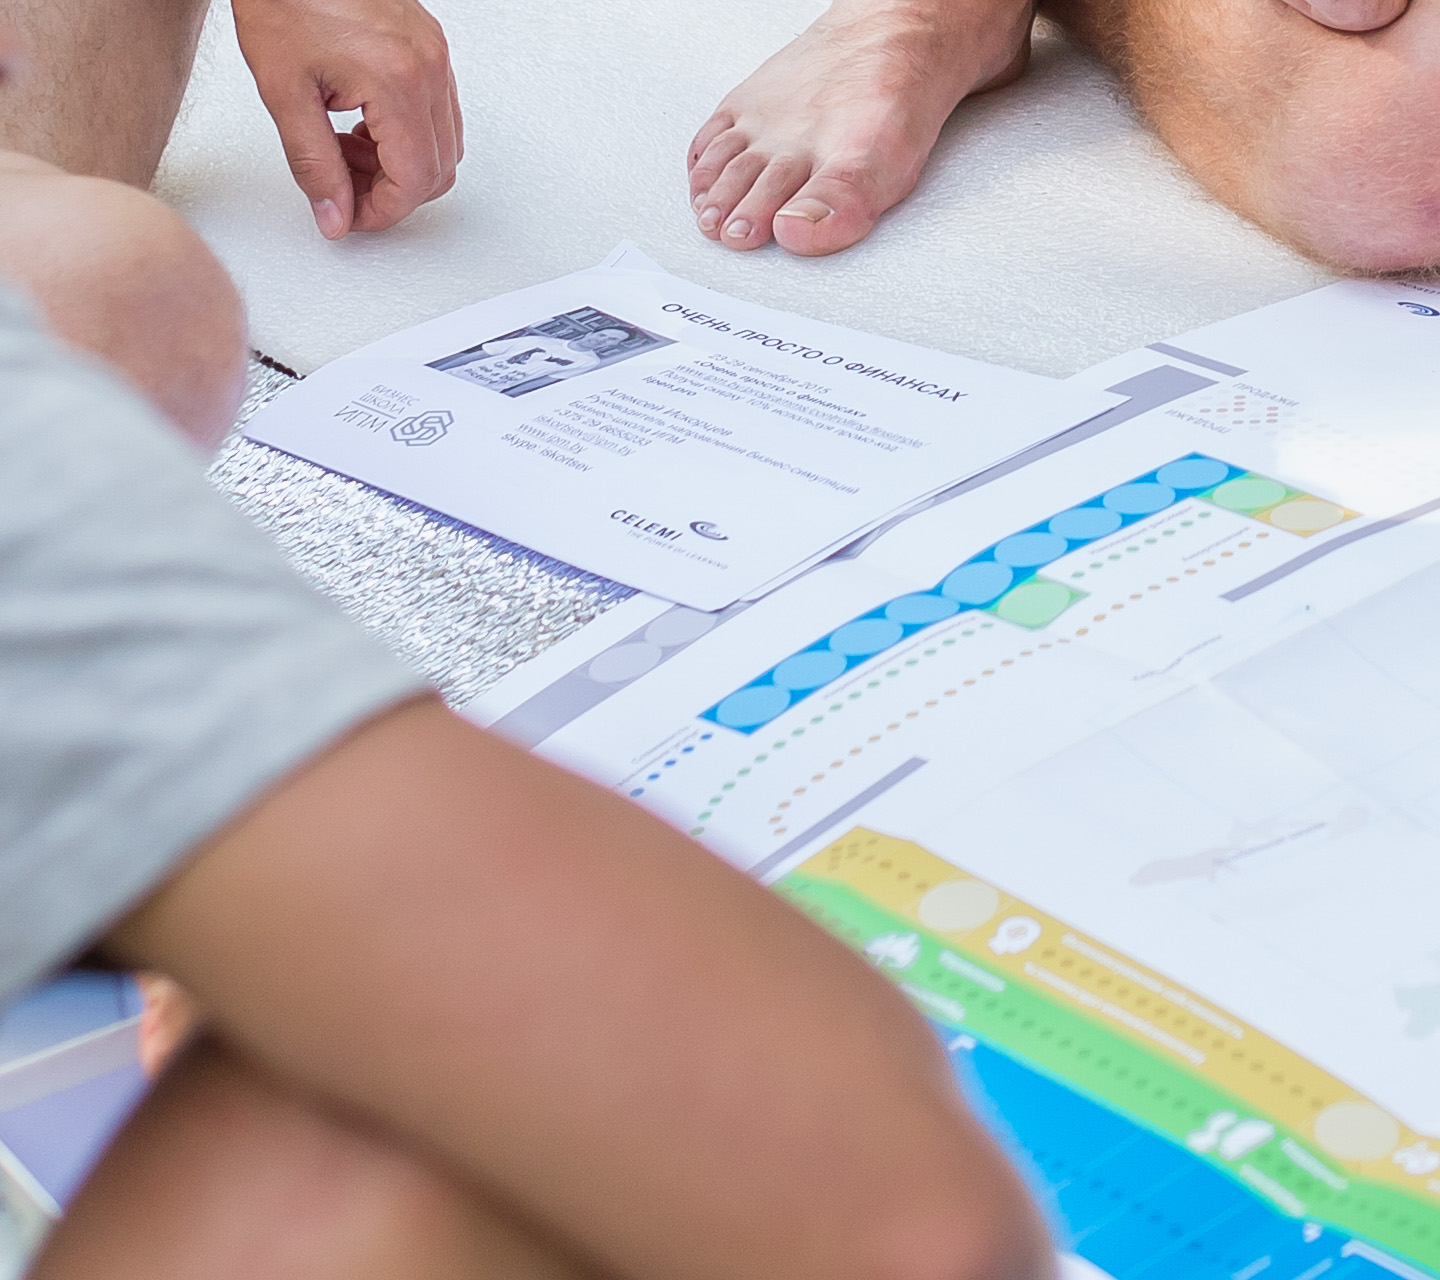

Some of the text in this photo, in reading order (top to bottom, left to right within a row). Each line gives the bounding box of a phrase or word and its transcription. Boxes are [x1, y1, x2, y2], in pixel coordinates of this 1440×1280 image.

[661, 303, 969, 403] ОЧЕНЬ ПРОСТО О ФИНАНСАХ
[1232, 382, 1301, 408] ПРОДАЖИ
[332, 405, 389, 434] ИПМ
[601, 388, 734, 437] Алексей Искорцев
[610, 509, 683, 541] CELEMI
